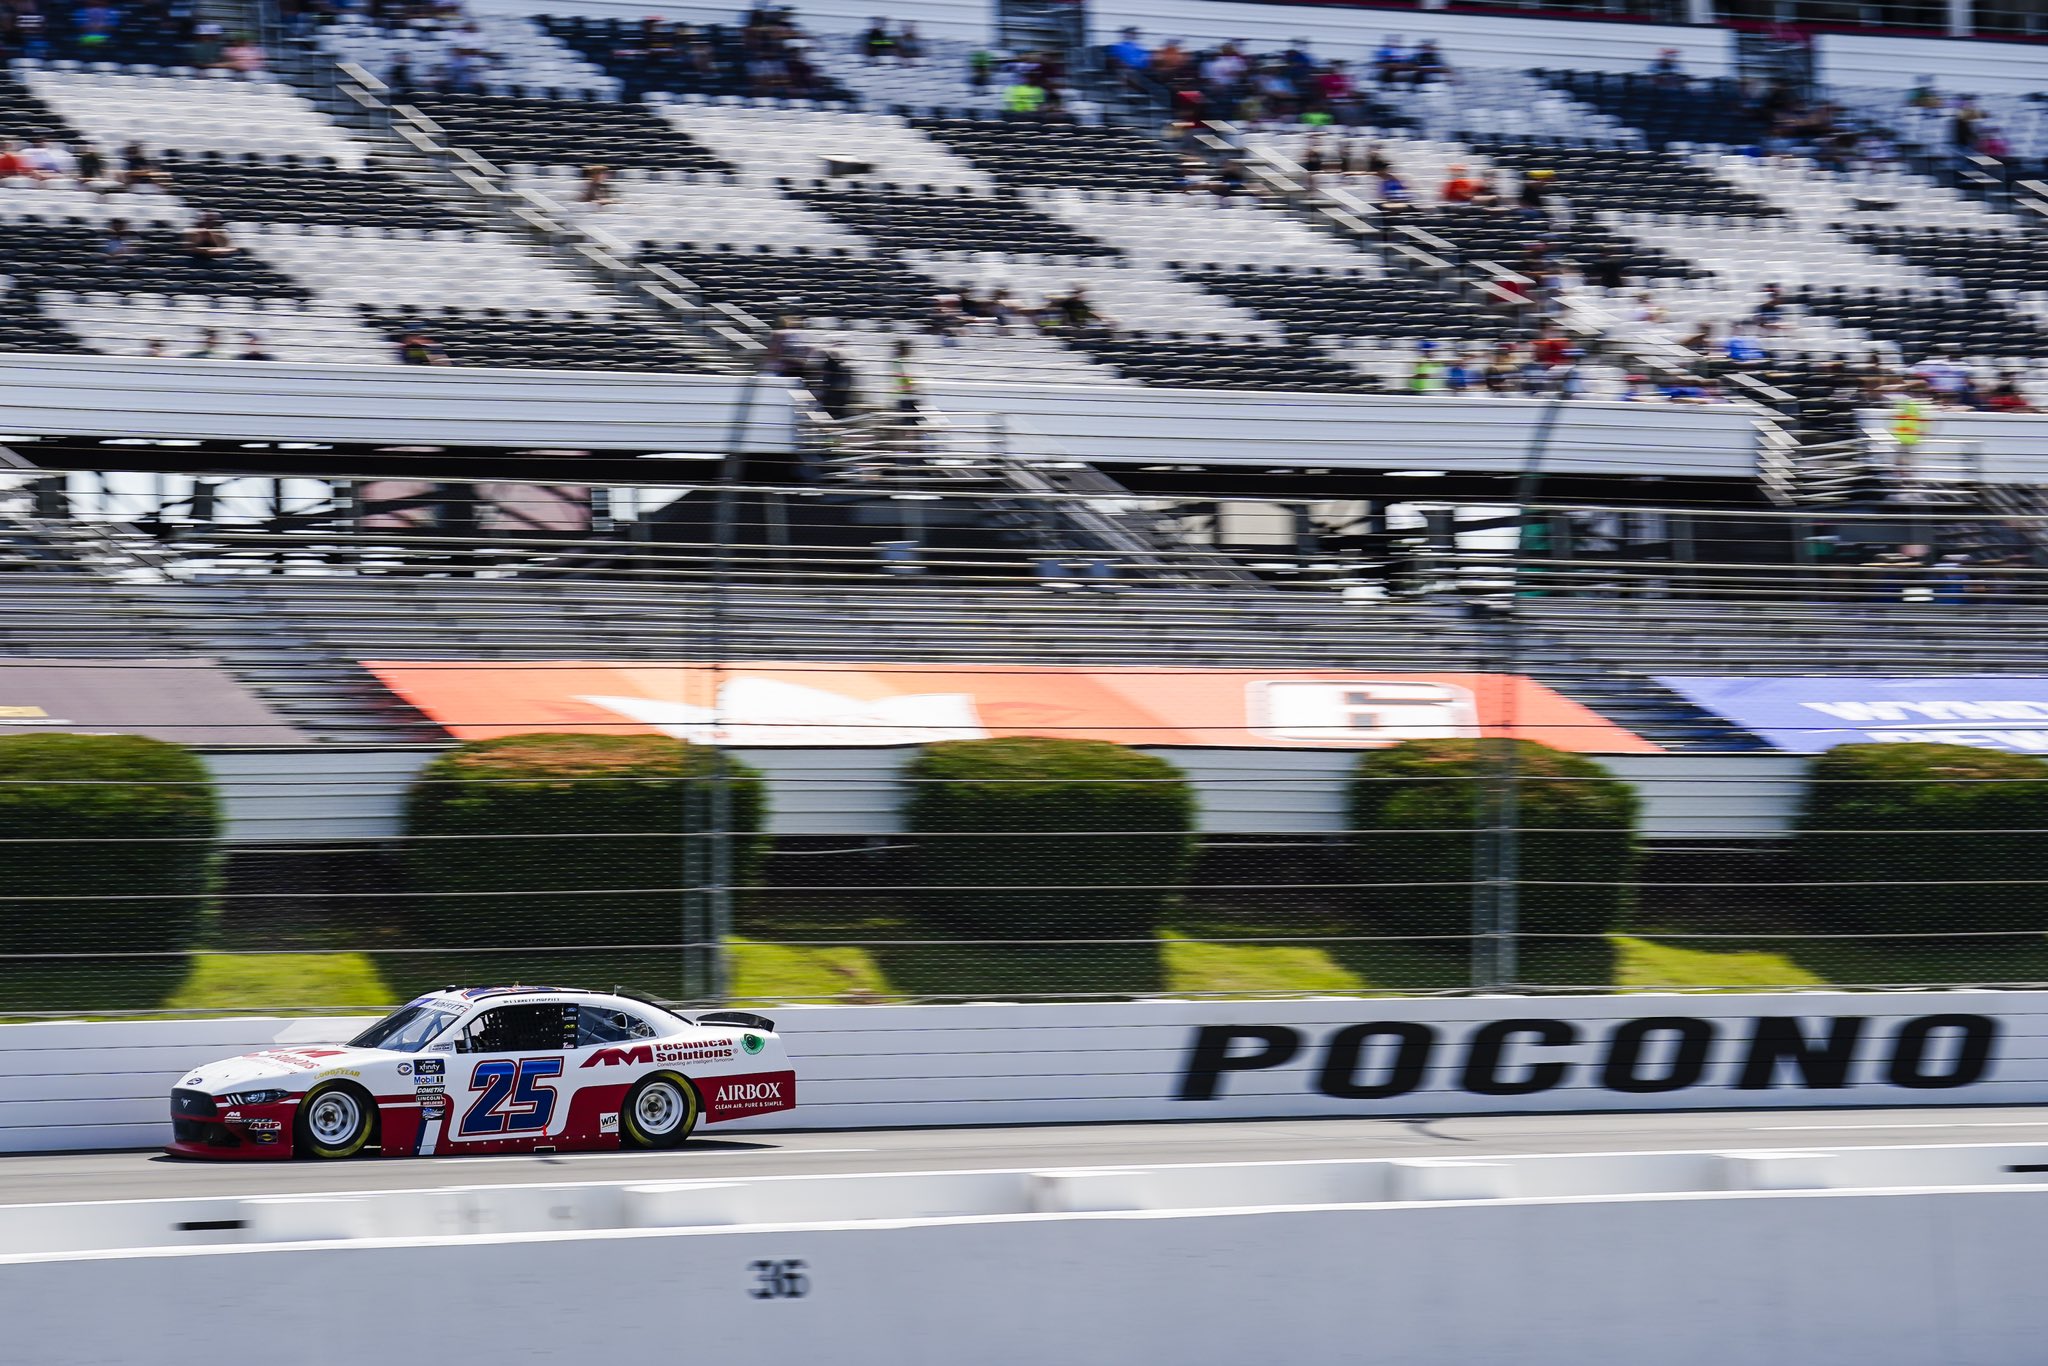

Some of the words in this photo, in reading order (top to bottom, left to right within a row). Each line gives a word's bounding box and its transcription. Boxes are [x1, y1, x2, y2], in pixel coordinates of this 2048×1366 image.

[654, 1039, 733, 1051] Technical
[656, 1048, 733, 1062] Solutions
[1177, 1013, 1998, 1102] POCONO
[415, 1076, 435, 1084] Mobil
[458, 1055, 565, 1137] 25
[715, 1082, 781, 1102] AIRBOX
[601, 1114, 618, 1126] WIX
[746, 1259, 811, 1299] 36
